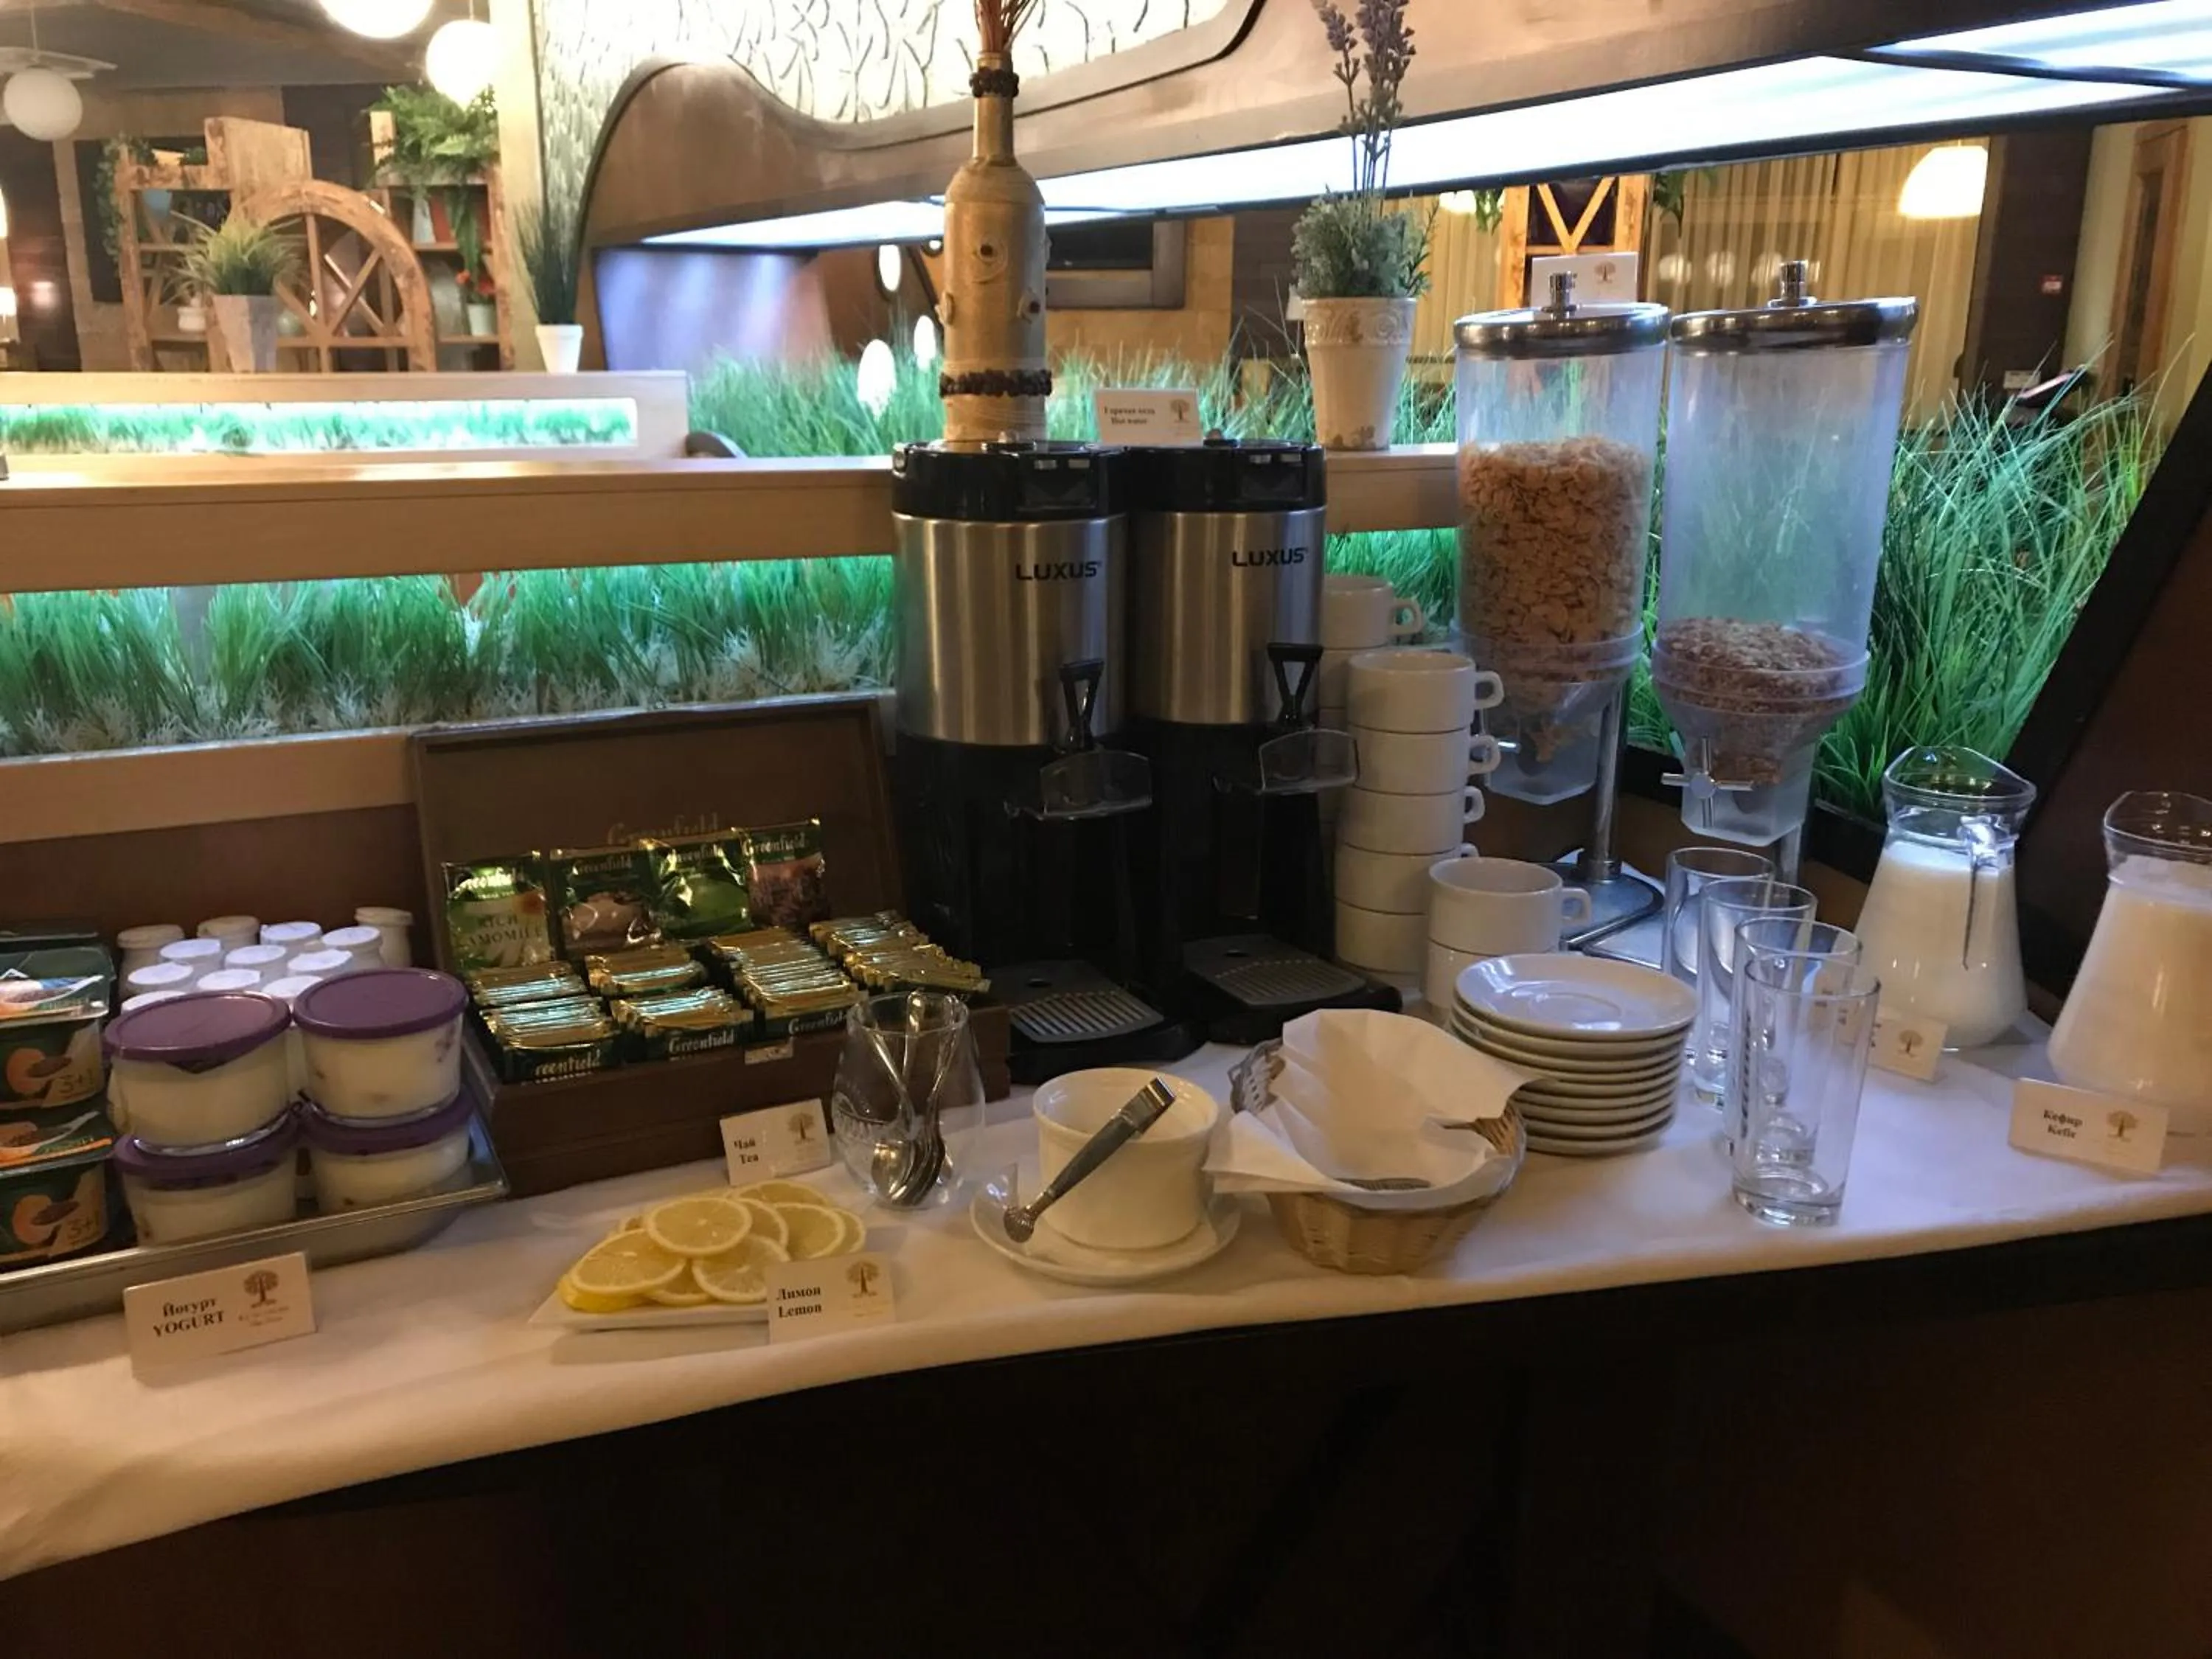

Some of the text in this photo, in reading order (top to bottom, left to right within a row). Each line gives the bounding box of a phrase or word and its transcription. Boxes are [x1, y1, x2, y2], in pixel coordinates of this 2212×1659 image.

[1231, 547, 1306, 567] LUXUS
[1015, 561, 1099, 581] LUXUS
[669, 1029, 734, 1054] Greenfield
[2043, 1109, 2083, 1128] Кефир
[740, 1154, 759, 1164] Tea
[776, 1286, 821, 1301] Лимон
[162, 1297, 217, 1318] Йогурт
[778, 1304, 822, 1318] Lemon
[153, 1310, 225, 1338] YOGURT
